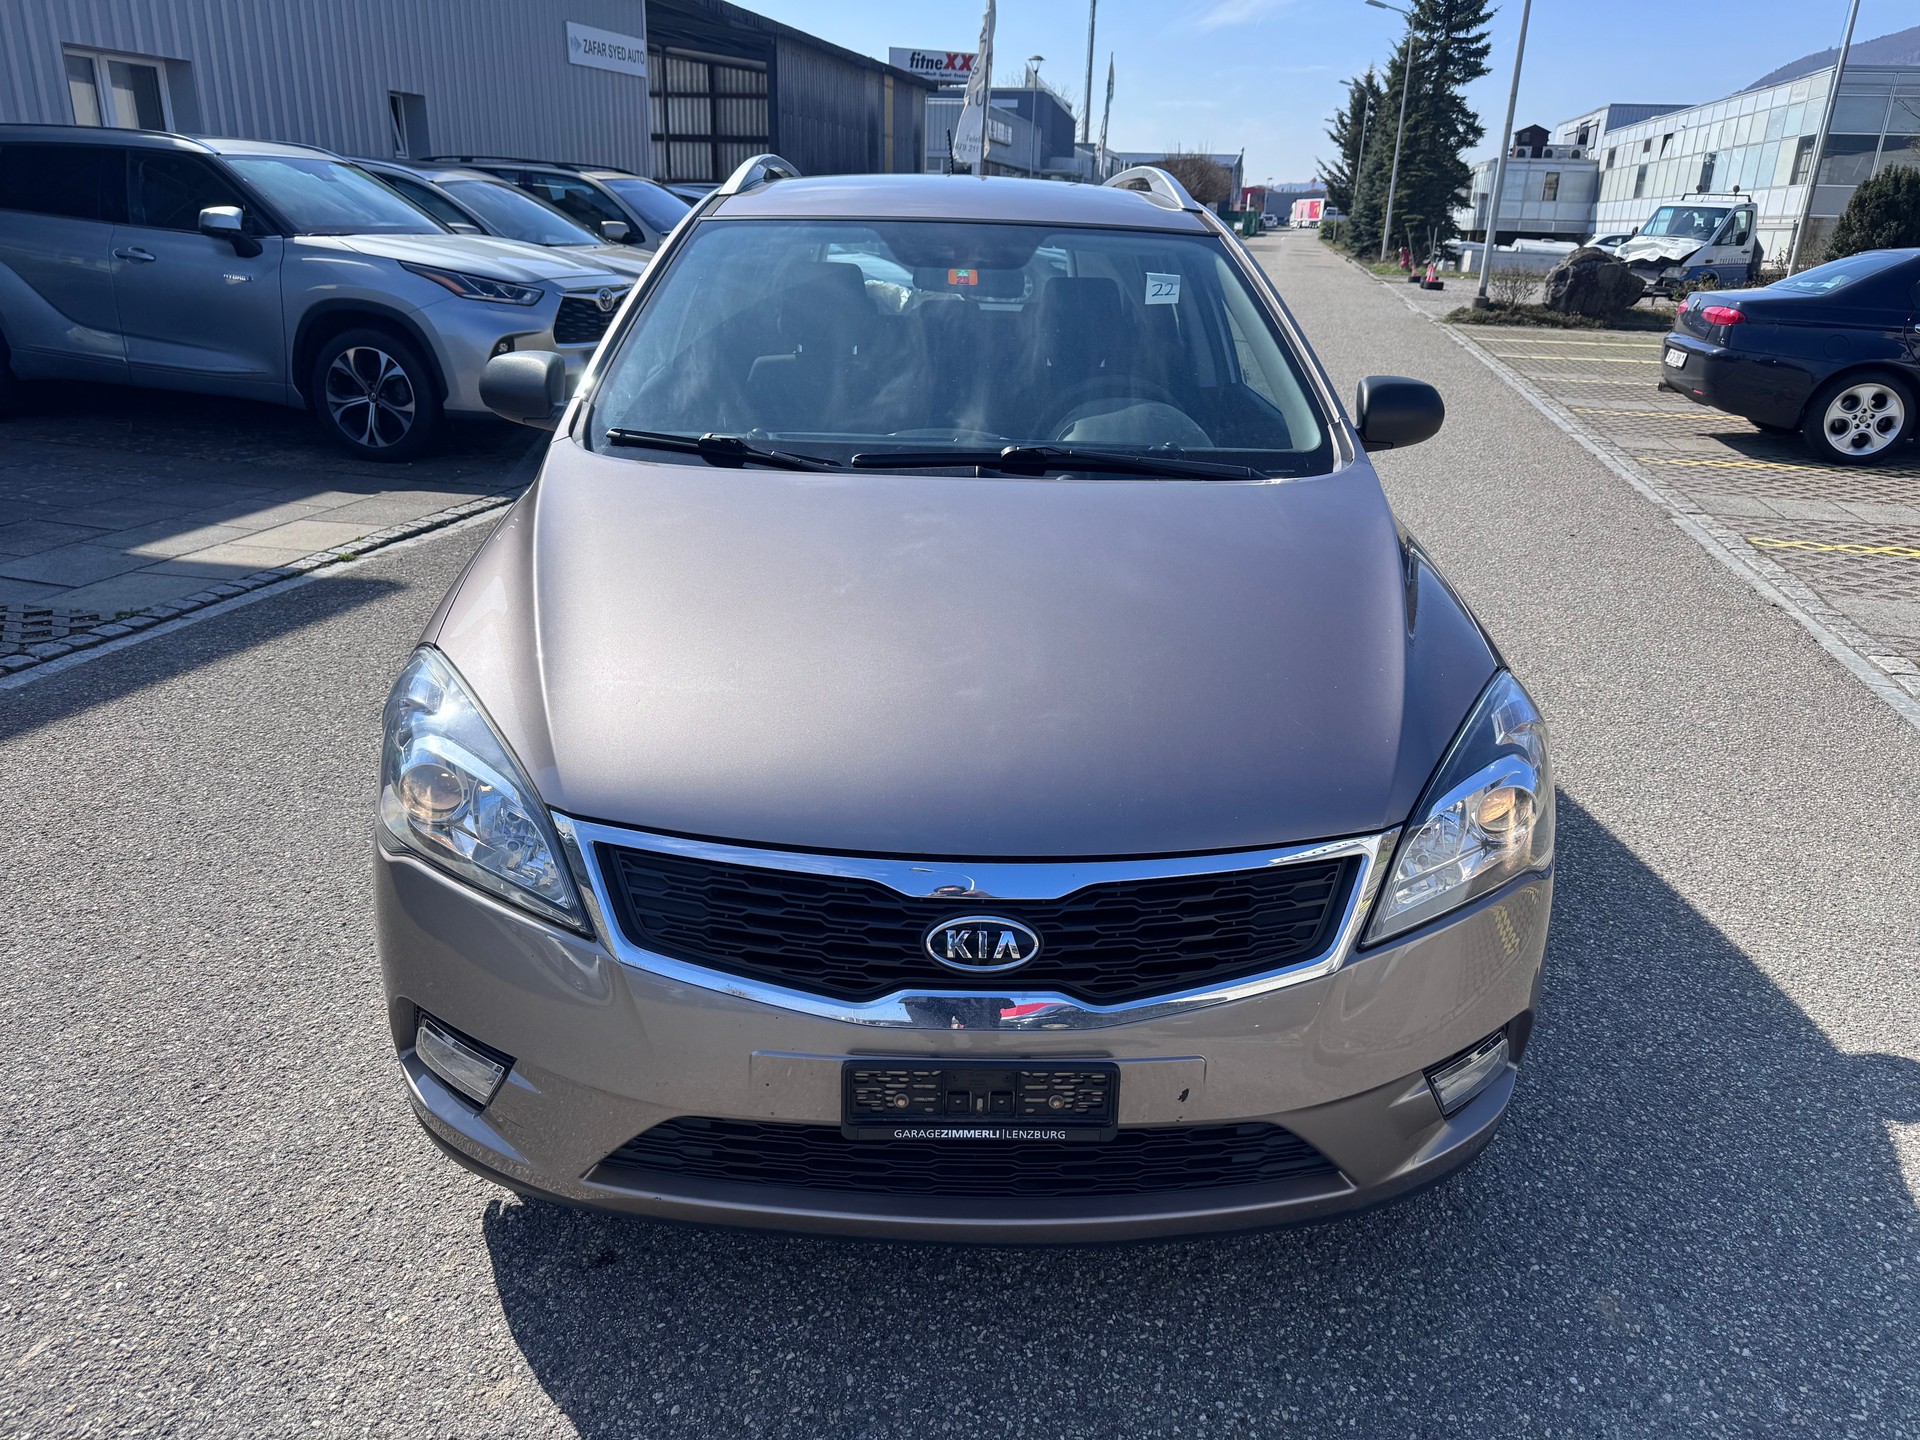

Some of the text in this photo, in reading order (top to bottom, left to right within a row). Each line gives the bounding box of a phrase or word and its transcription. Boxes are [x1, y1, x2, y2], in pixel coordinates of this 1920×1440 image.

[583, 38, 645, 64] ZAFAR SYED AUTO
[1152, 282, 1176, 297] 22
[945, 929, 1021, 959] KIA
[1006, 1130, 1066, 1140] LENZBURG
